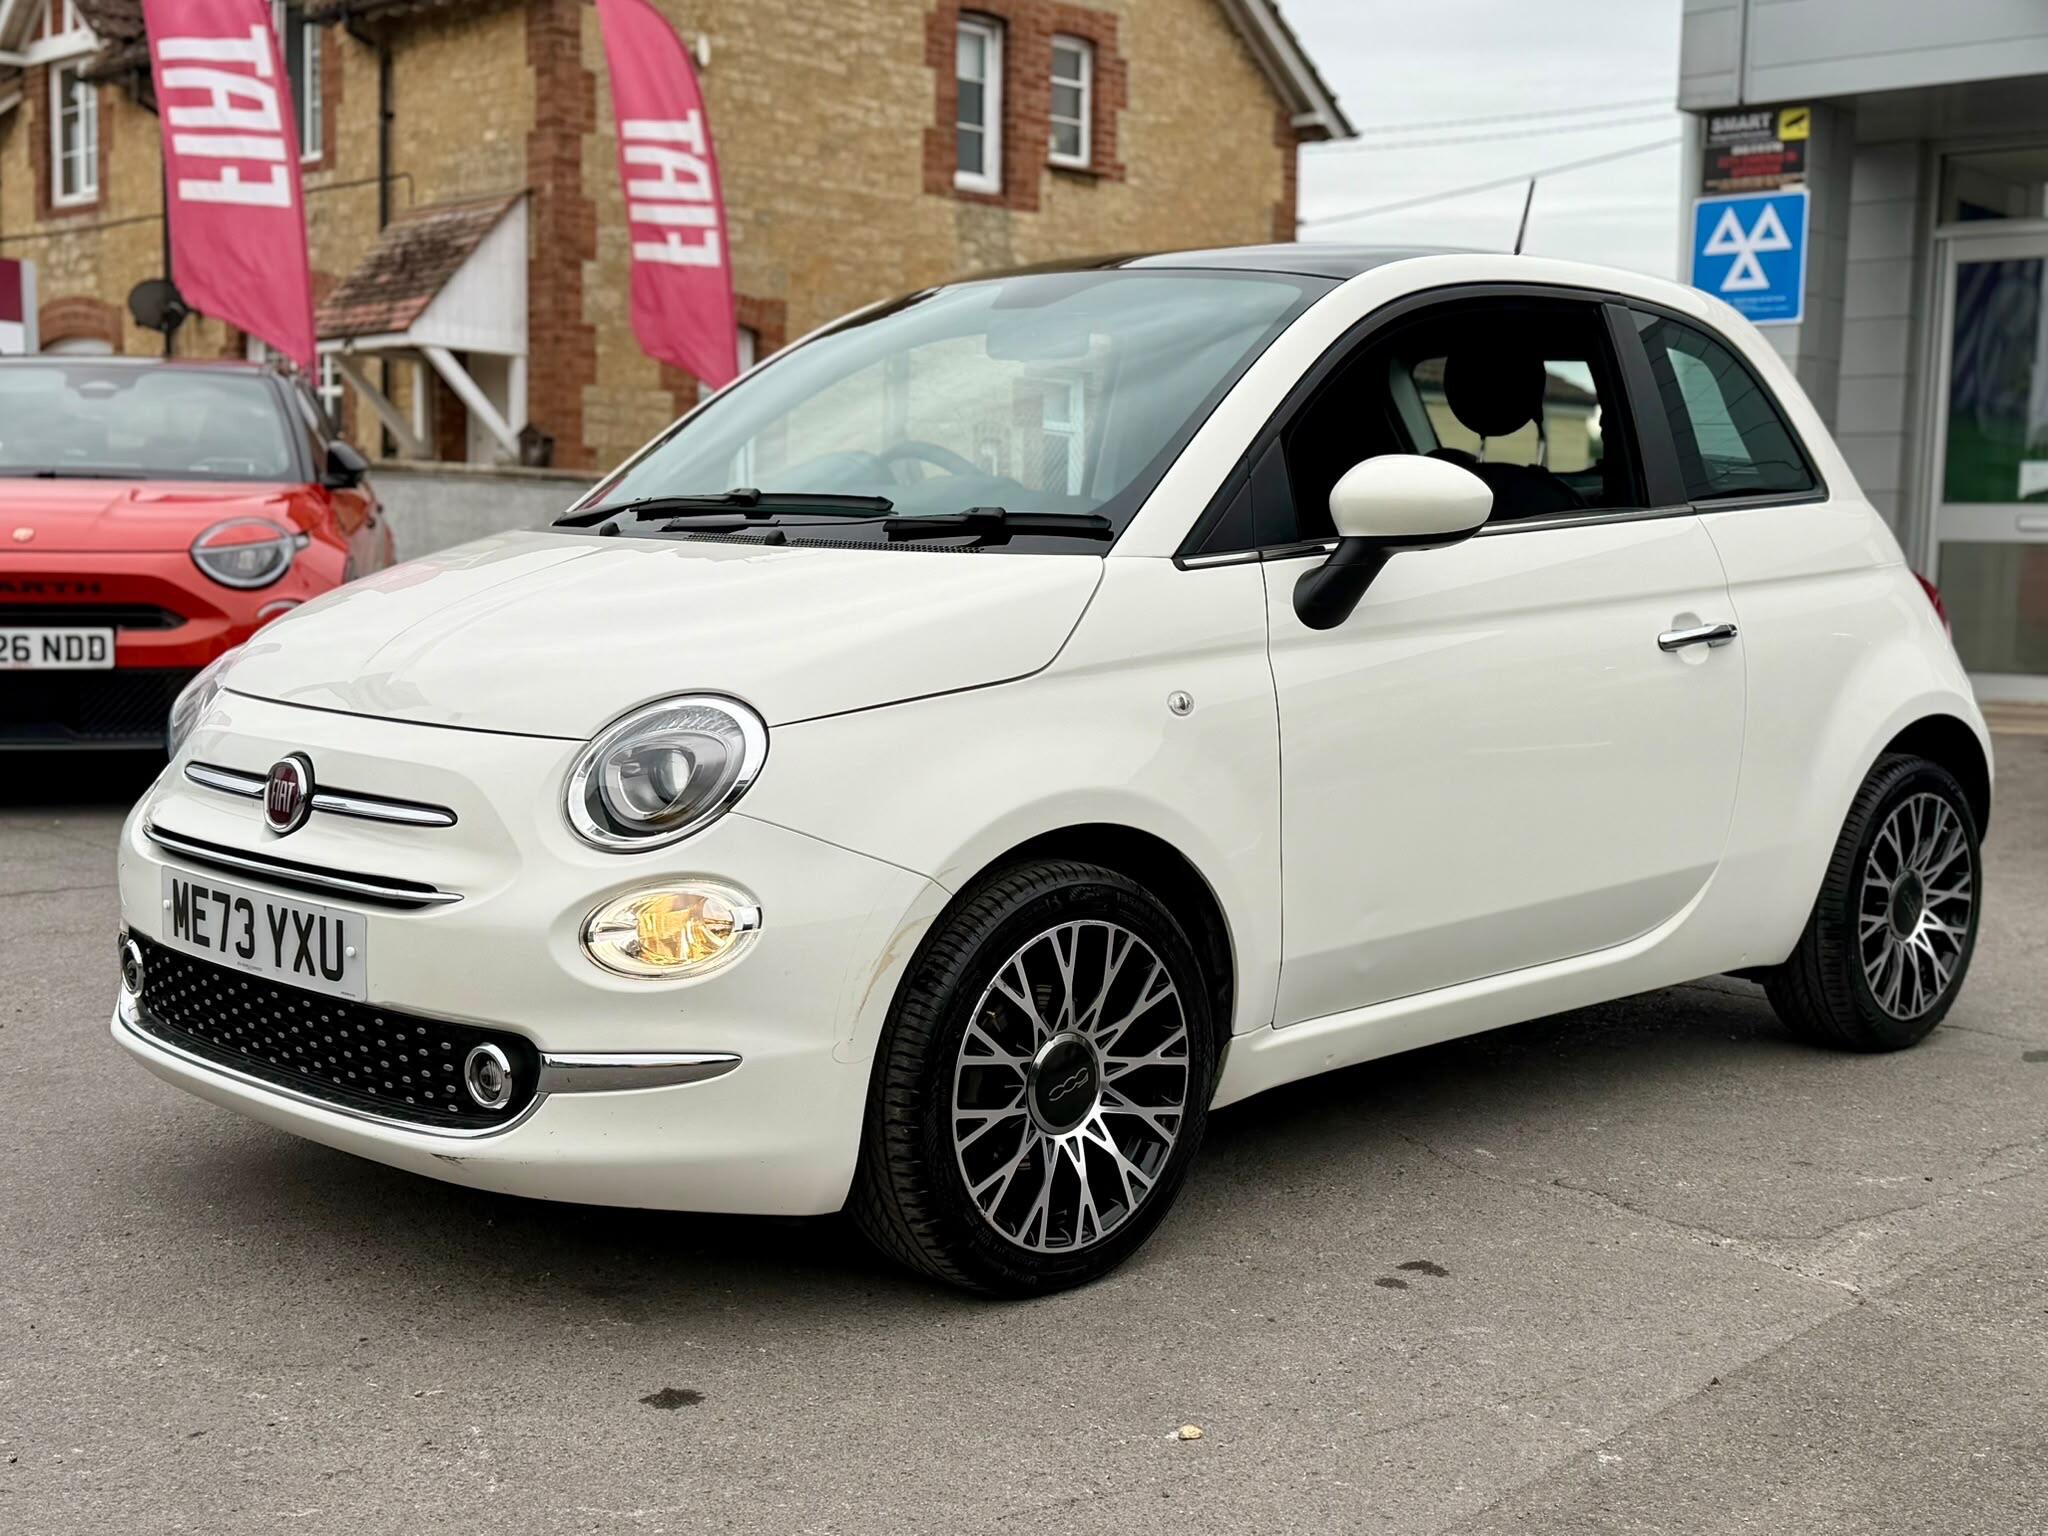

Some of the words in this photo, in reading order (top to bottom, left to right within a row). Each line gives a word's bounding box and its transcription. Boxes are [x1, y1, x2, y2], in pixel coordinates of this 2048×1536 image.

[1711, 112, 1774, 134] SMART
[43, 635, 106, 661] NDD
[271, 778, 297, 813] FIAT
[172, 878, 255, 960] ME73
[266, 904, 344, 982] YXU
